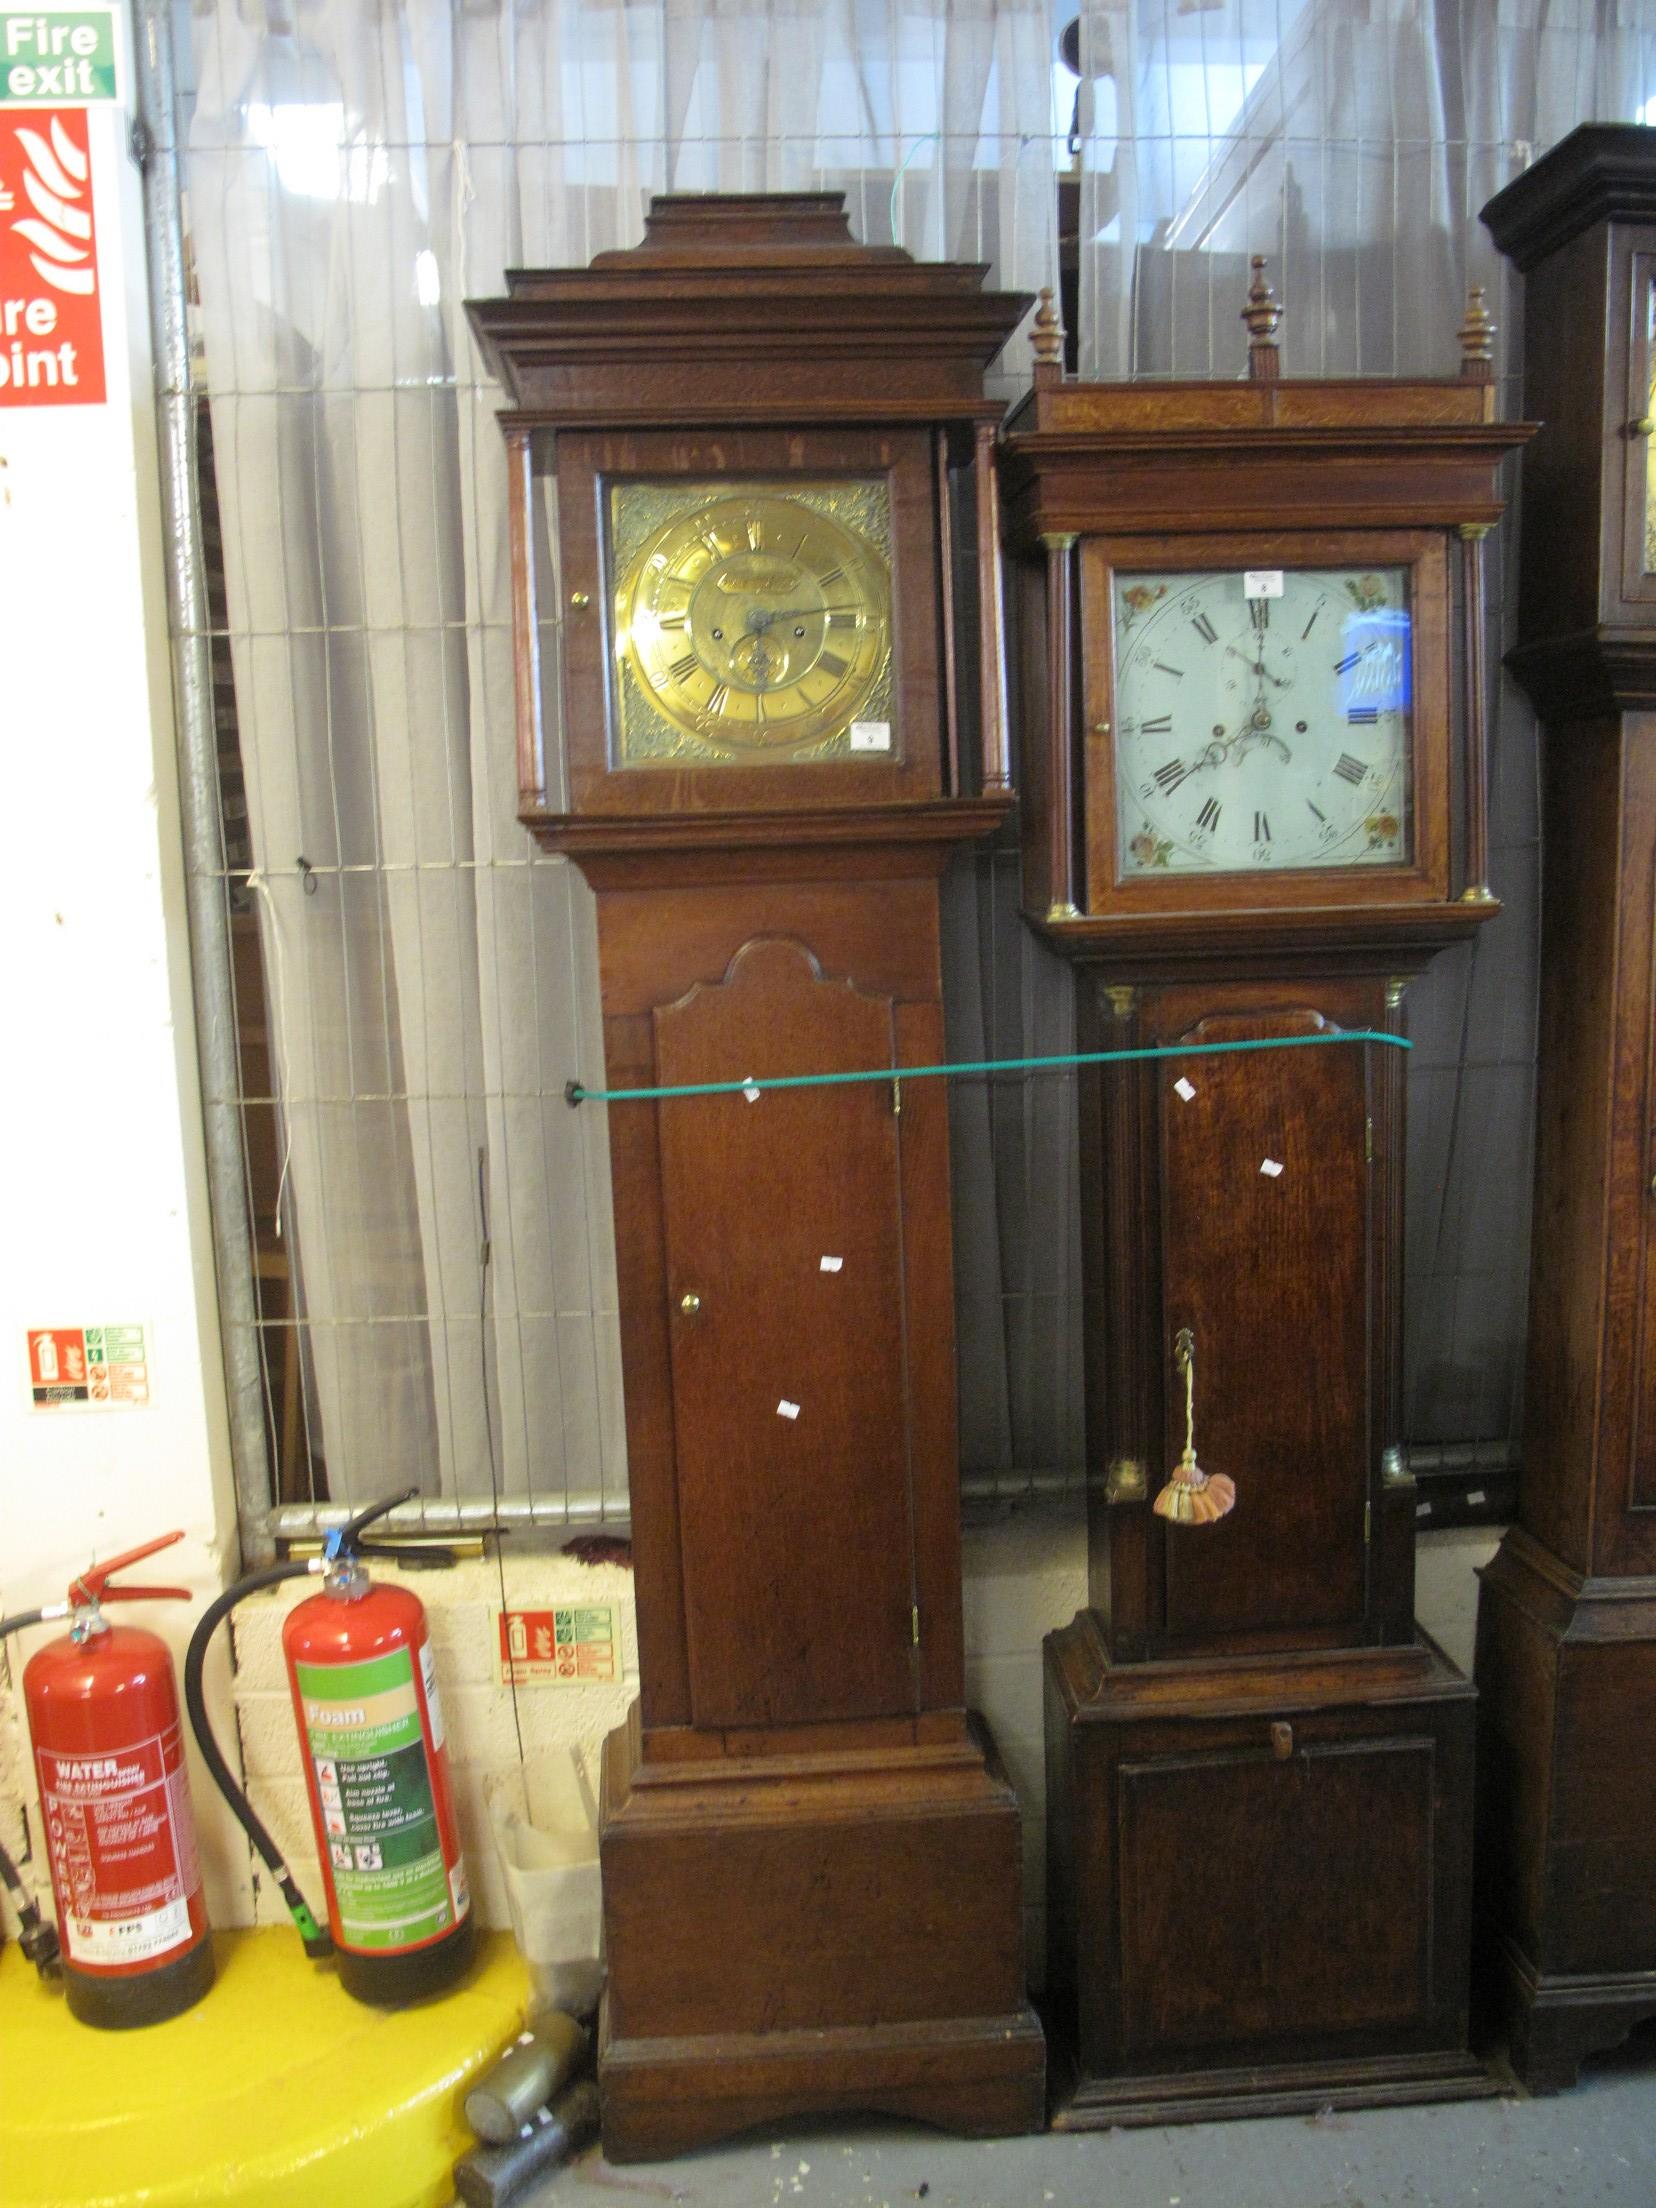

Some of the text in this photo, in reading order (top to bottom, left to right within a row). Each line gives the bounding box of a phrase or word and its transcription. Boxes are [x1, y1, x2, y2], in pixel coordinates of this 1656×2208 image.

[6, 17, 98, 56] Fire
[8, 57, 95, 95] exit
[0, 297, 57, 337] re
[309, 1703, 365, 1726] Foam
[56, 1759, 118, 1780] WATER
